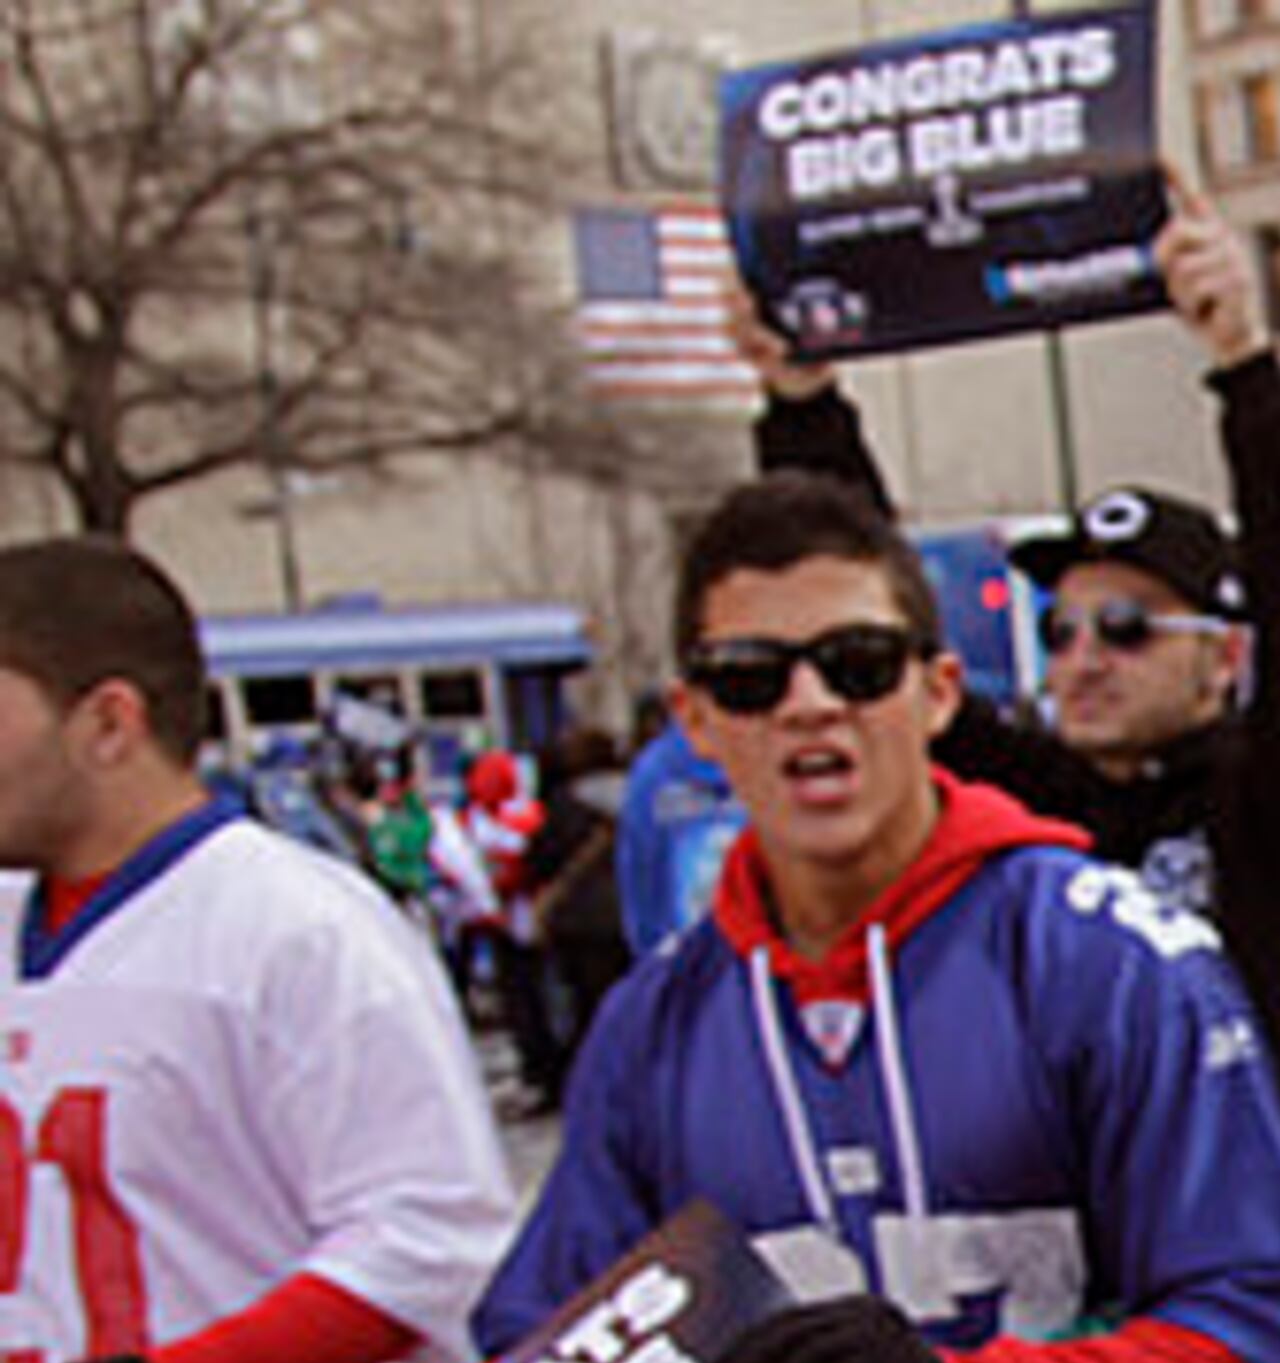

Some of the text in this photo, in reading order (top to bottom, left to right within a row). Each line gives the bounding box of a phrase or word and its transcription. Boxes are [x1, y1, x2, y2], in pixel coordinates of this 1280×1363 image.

[759, 27, 1116, 139] CONGRATS
[788, 127, 901, 197] BIG
[909, 94, 1086, 176] BLUE
